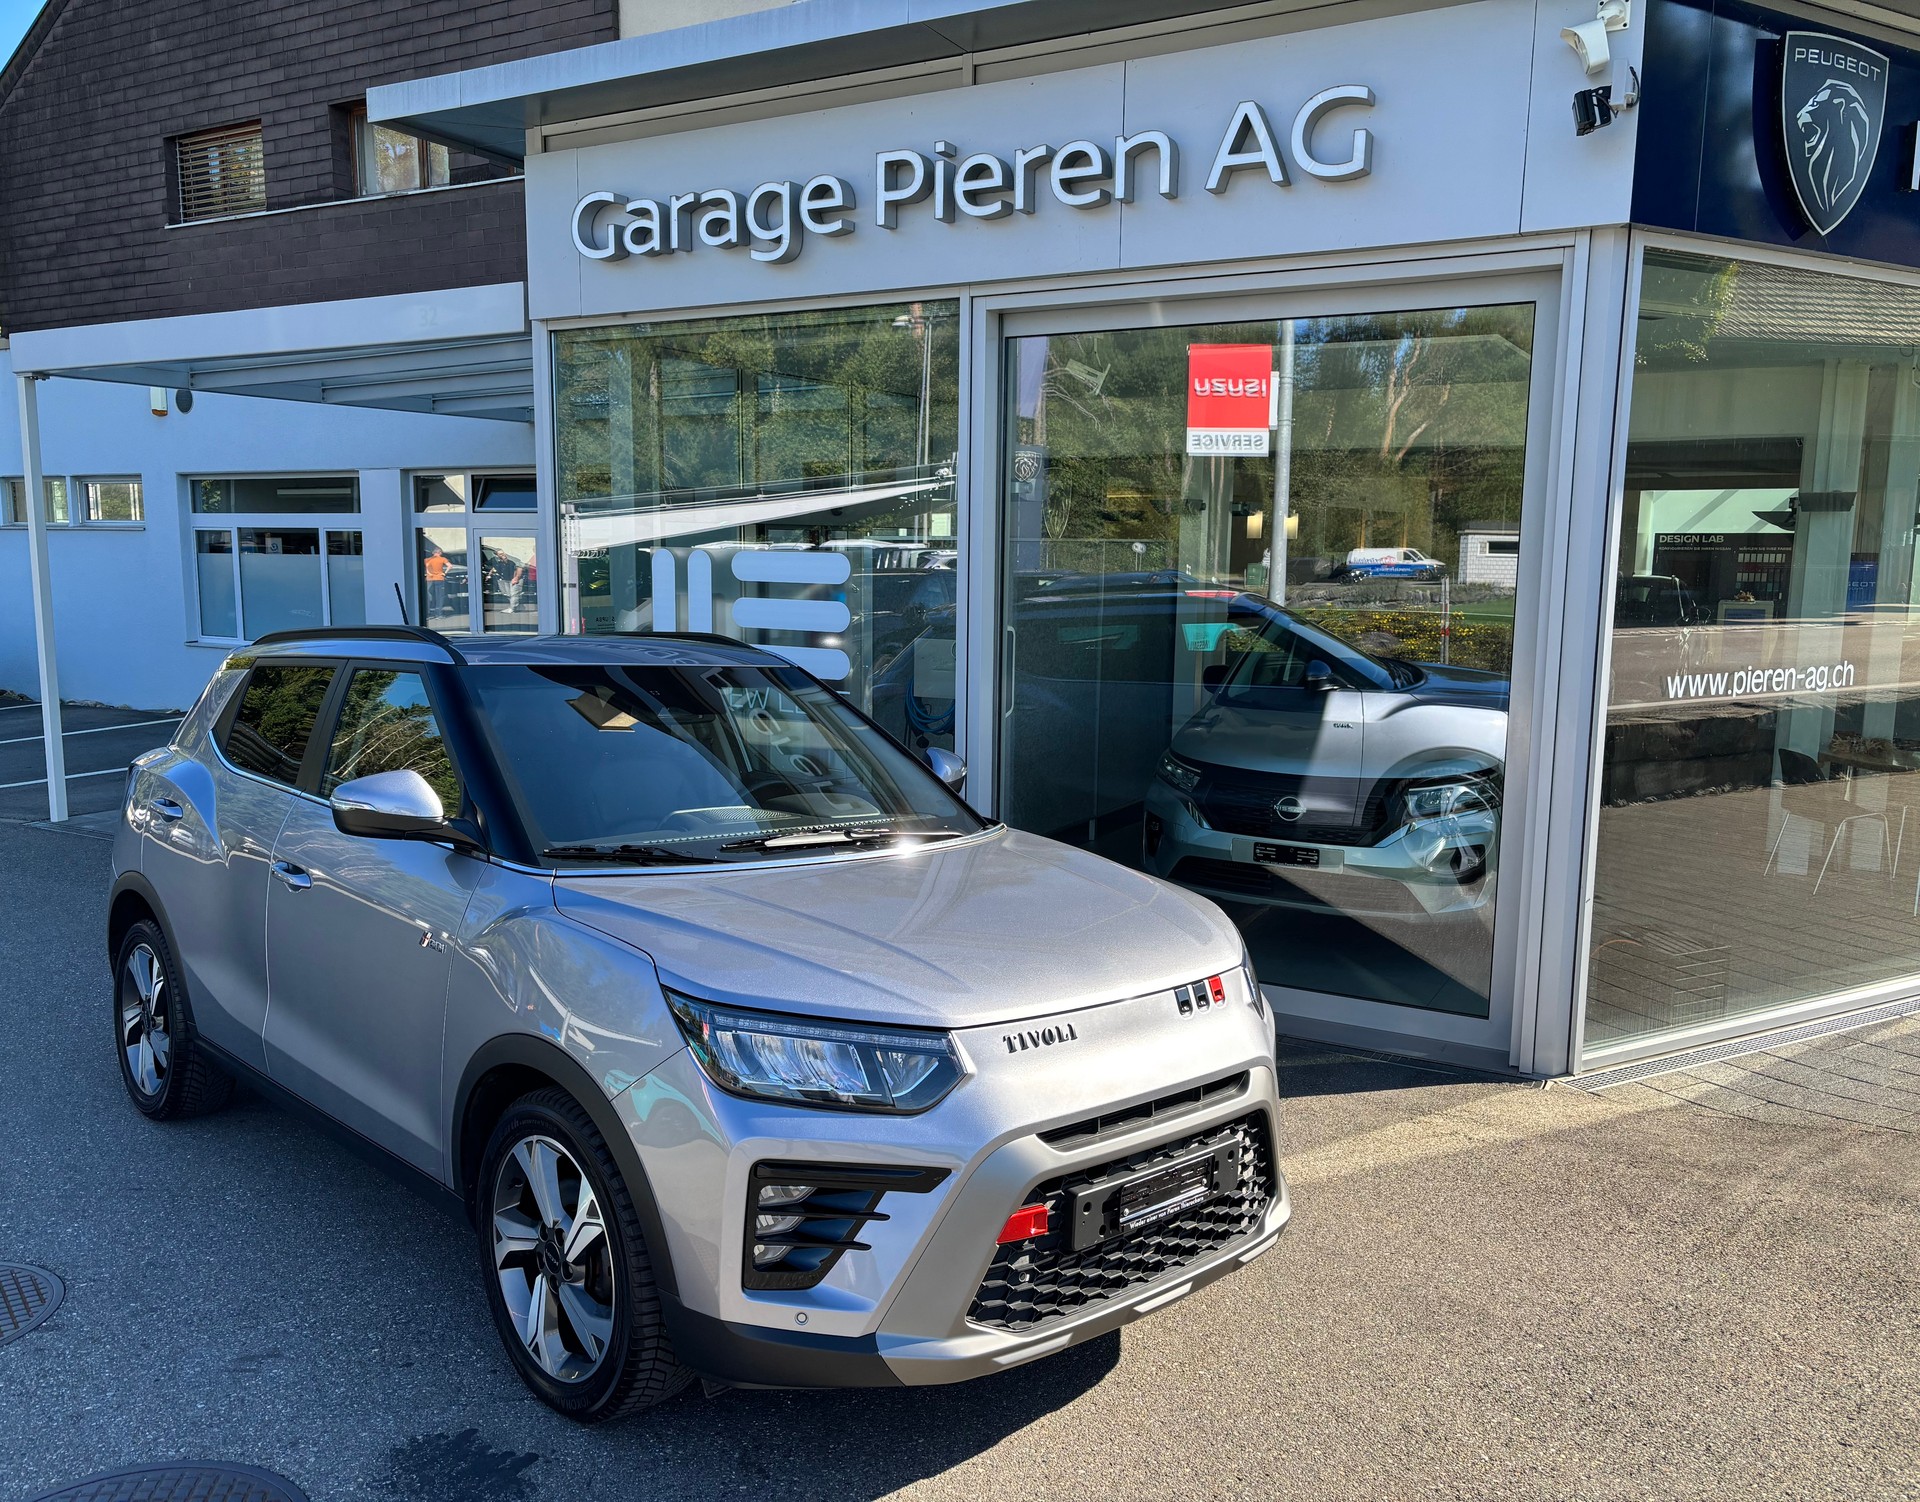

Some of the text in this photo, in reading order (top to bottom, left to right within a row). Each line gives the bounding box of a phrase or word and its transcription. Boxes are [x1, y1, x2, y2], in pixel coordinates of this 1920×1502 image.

[1794, 48, 1881, 81] PEUGEOT
[571, 84, 1377, 264] Garage Pieren AG
[1659, 534, 1725, 544] DESIGN LAB
[1666, 660, 1855, 698] www.pieren-ag.ch
[1002, 1023, 1078, 1054] TIVOLI
